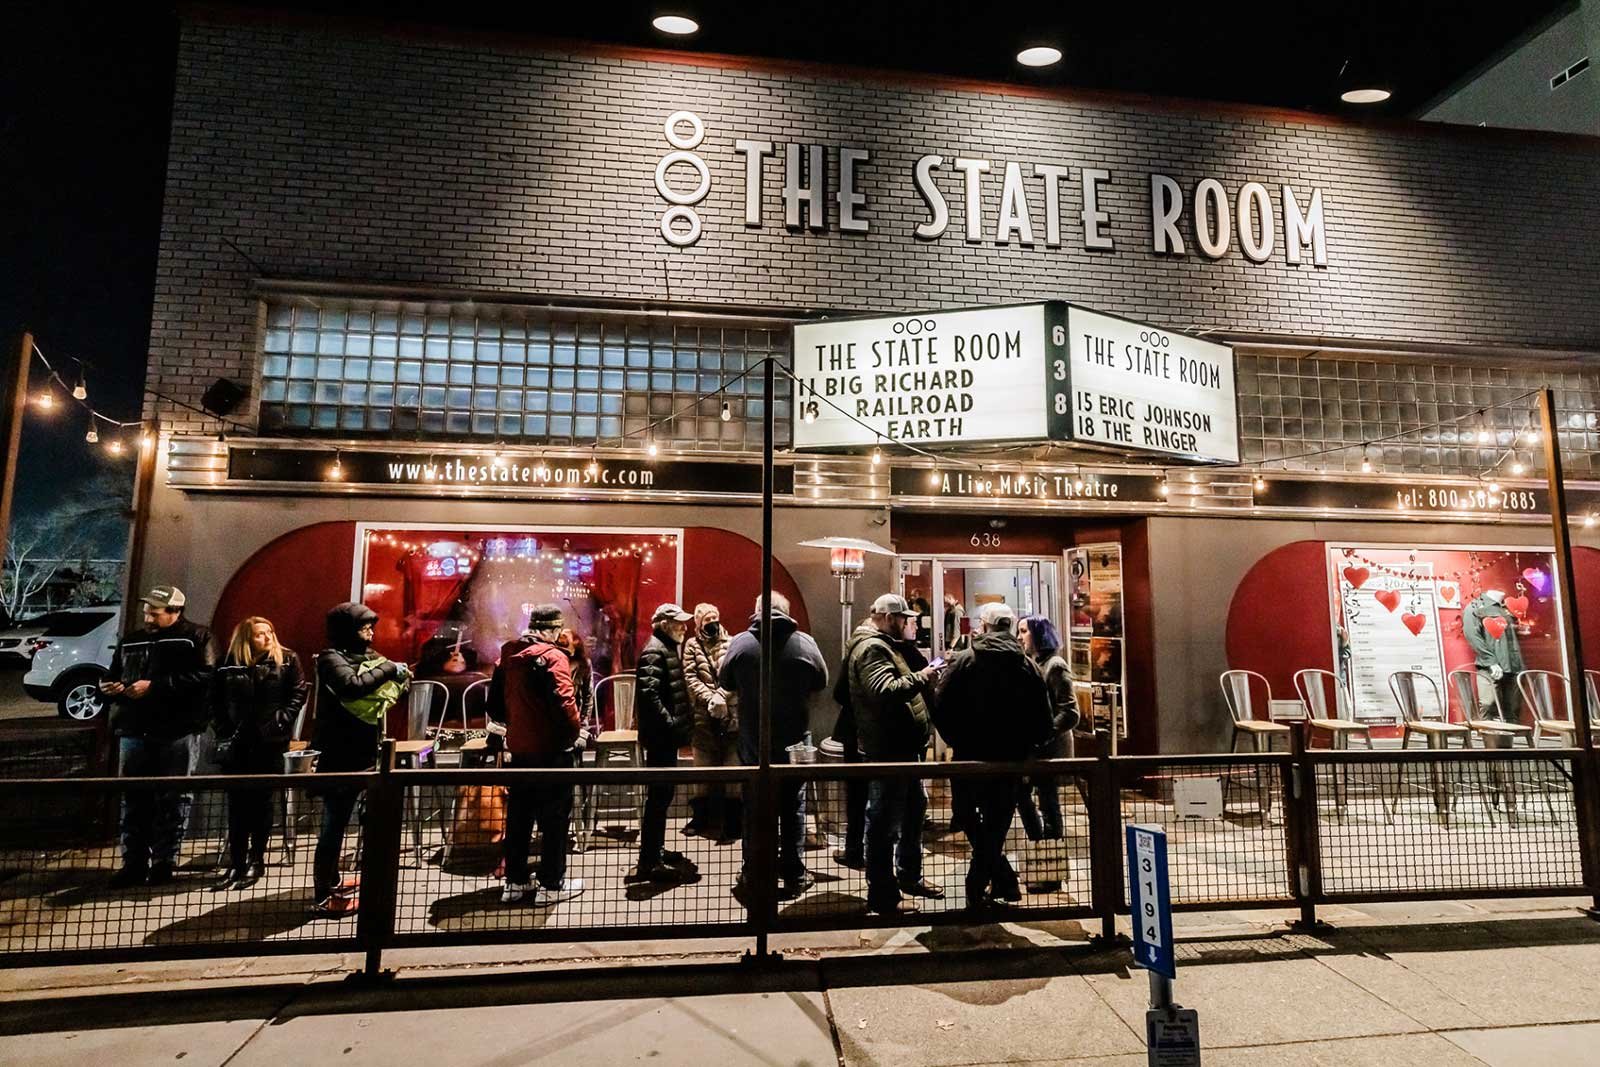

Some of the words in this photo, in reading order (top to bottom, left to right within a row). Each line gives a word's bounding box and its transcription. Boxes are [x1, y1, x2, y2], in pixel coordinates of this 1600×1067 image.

[735, 139, 870, 232] THE
[913, 154, 1114, 249] STATE
[1151, 174, 1327, 266] ROOM
[815, 343, 856, 371] THE
[872, 337, 938, 368] STATE
[954, 330, 1021, 362] ROOM
[1084, 334, 1115, 367] THE
[1125, 345, 1170, 379] STATE
[1179, 356, 1220, 389] ROOM
[800, 378, 815, 396] 11
[825, 377, 862, 396] BIG
[875, 369, 974, 393] RICHARD
[856, 393, 974, 417] RAILROAD
[1077, 391, 1092, 411] 15
[1100, 395, 1135, 420] ERIC
[1144, 404, 1211, 432] JOHNSON
[887, 418, 962, 439] EARTH
[1078, 415, 1095, 436] 18
[1103, 420, 1133, 442] THE
[1143, 427, 1198, 452] RINGER
[941, 473, 951, 493] A
[1000, 475, 1048, 496] Music
[1397, 489, 1423, 507] tel:
[970, 532, 1001, 547] 638
